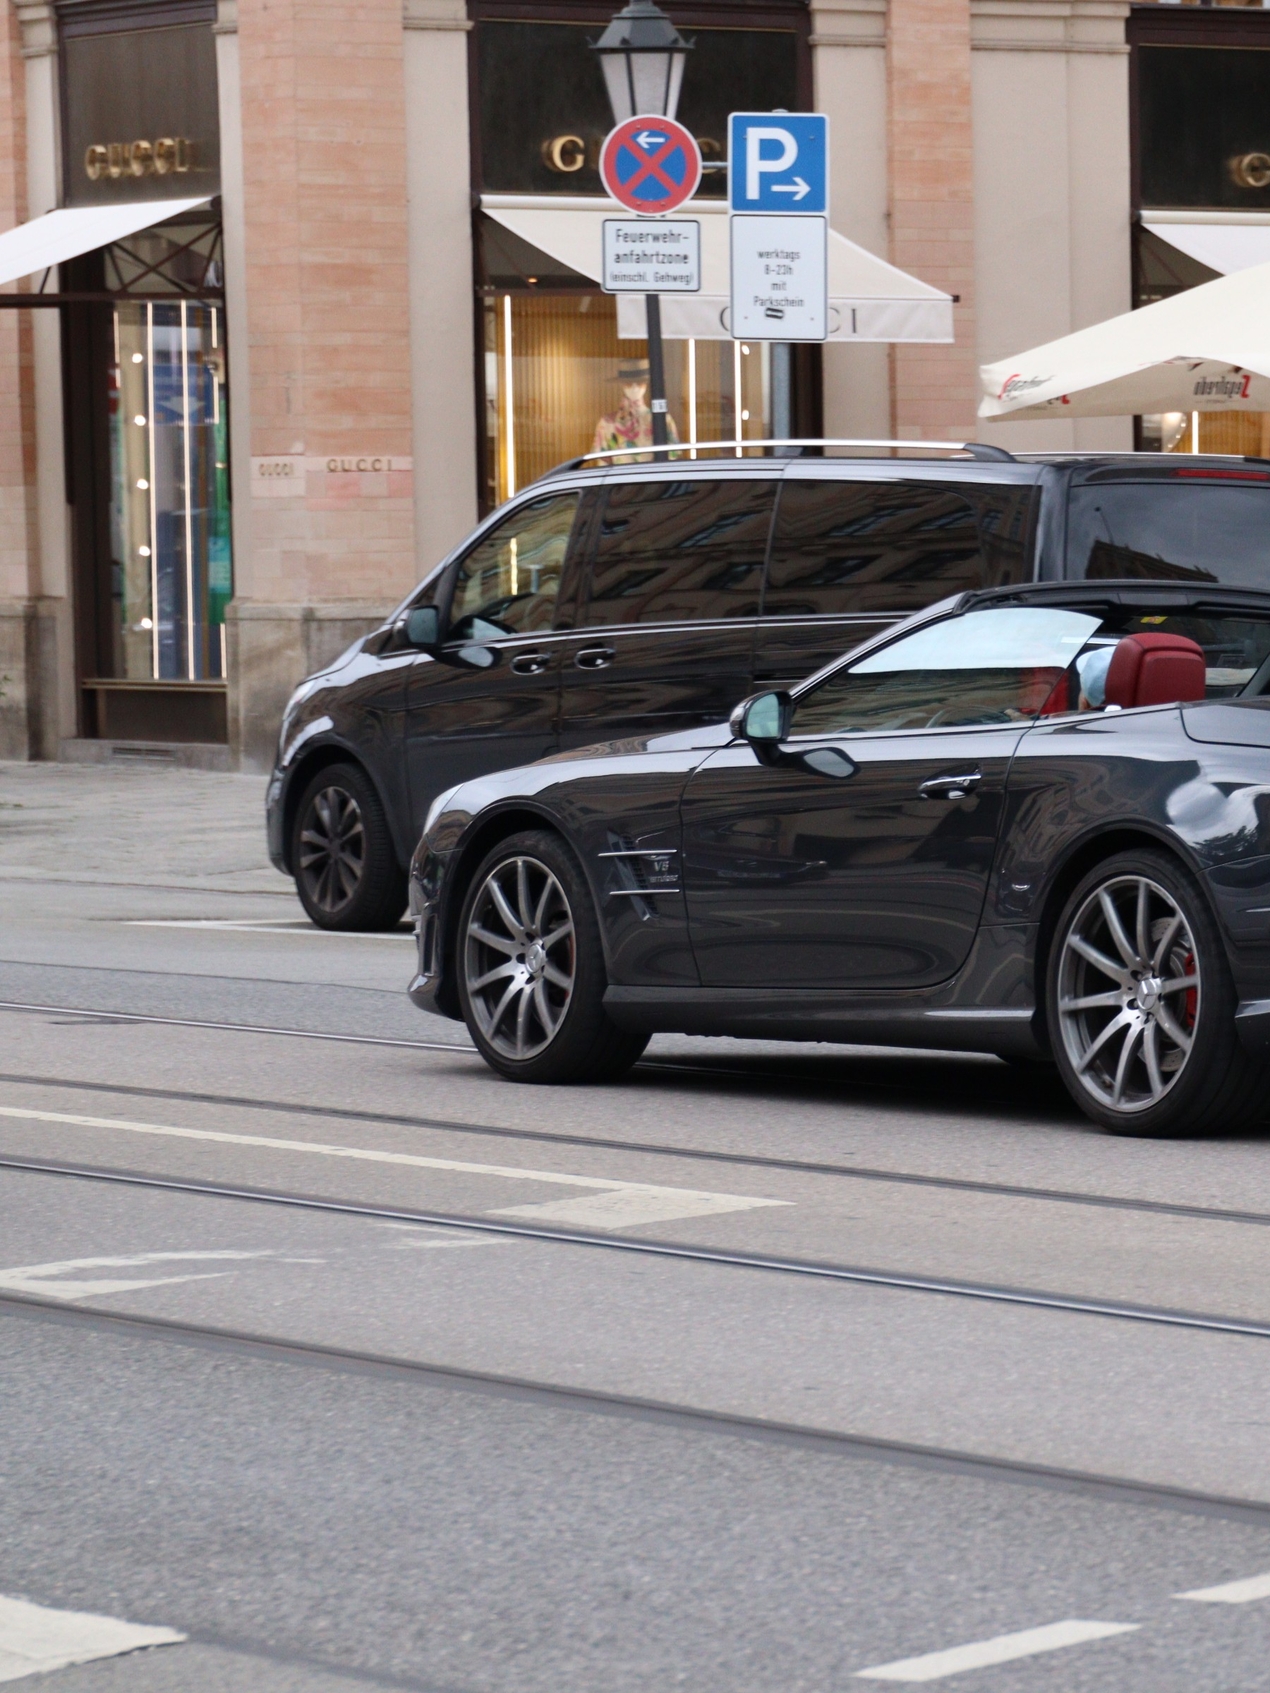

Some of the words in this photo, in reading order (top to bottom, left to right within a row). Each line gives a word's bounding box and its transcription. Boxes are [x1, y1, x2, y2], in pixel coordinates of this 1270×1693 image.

[85, 138, 190, 180] GUCCI
[746, 127, 798, 200] P
[615, 229, 690, 244] Feuerwehr-
[614, 250, 689, 265] anfahrtzone
[757, 248, 801, 262] werktags
[653, 271, 694, 286] Gehweg)
[771, 280, 787, 291] mit
[753, 295, 804, 308] Parkschein
[326, 458, 392, 472] GUCCI
